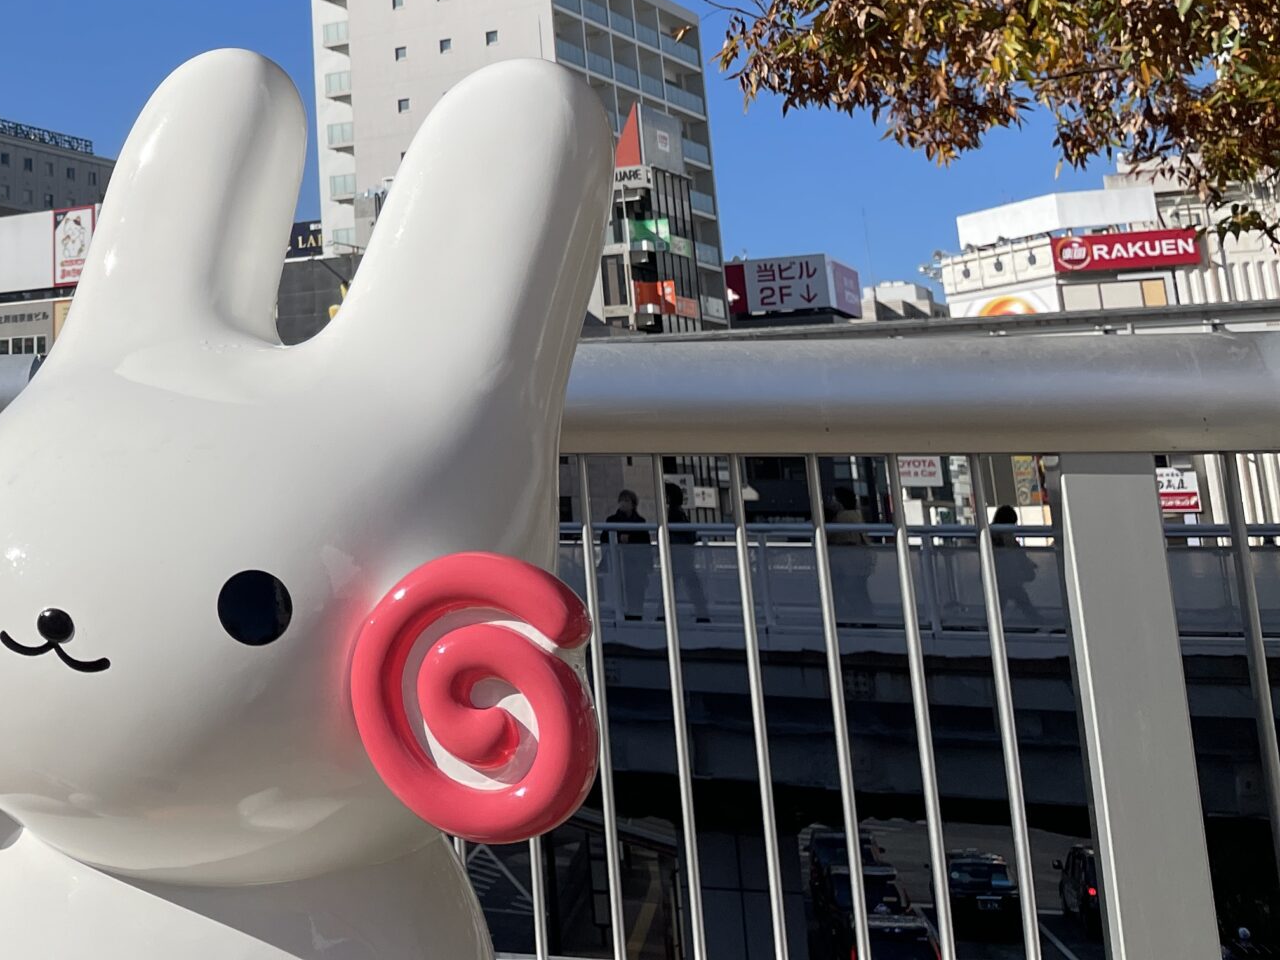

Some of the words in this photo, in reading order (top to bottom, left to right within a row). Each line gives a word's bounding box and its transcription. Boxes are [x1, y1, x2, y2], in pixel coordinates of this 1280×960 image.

[1092, 238, 1195, 261] RAKUEN
[757, 260, 817, 283] 当ビル
[759, 284, 792, 307] 2F
[899, 459, 936, 469] OYOTA
